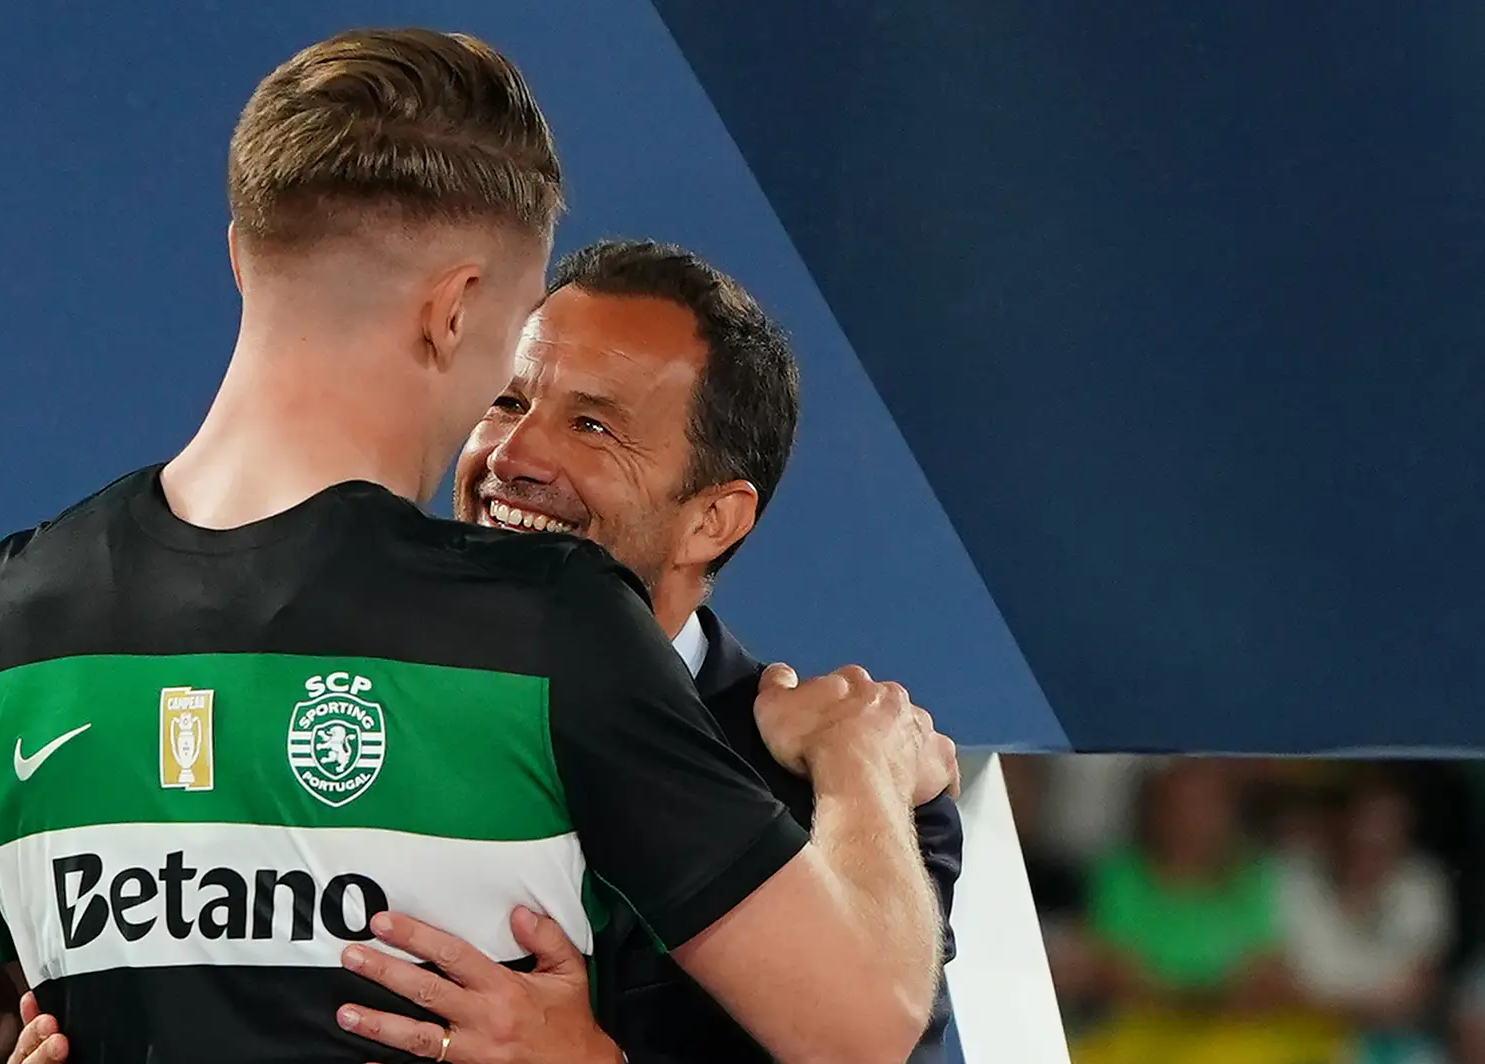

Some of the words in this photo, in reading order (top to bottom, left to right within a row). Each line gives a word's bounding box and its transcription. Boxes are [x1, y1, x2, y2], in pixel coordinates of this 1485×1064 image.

[305, 671, 372, 698] SCP
[298, 702, 375, 729] SPORTING
[301, 770, 372, 793] PORTUGAL
[52, 850, 390, 950] Betano
